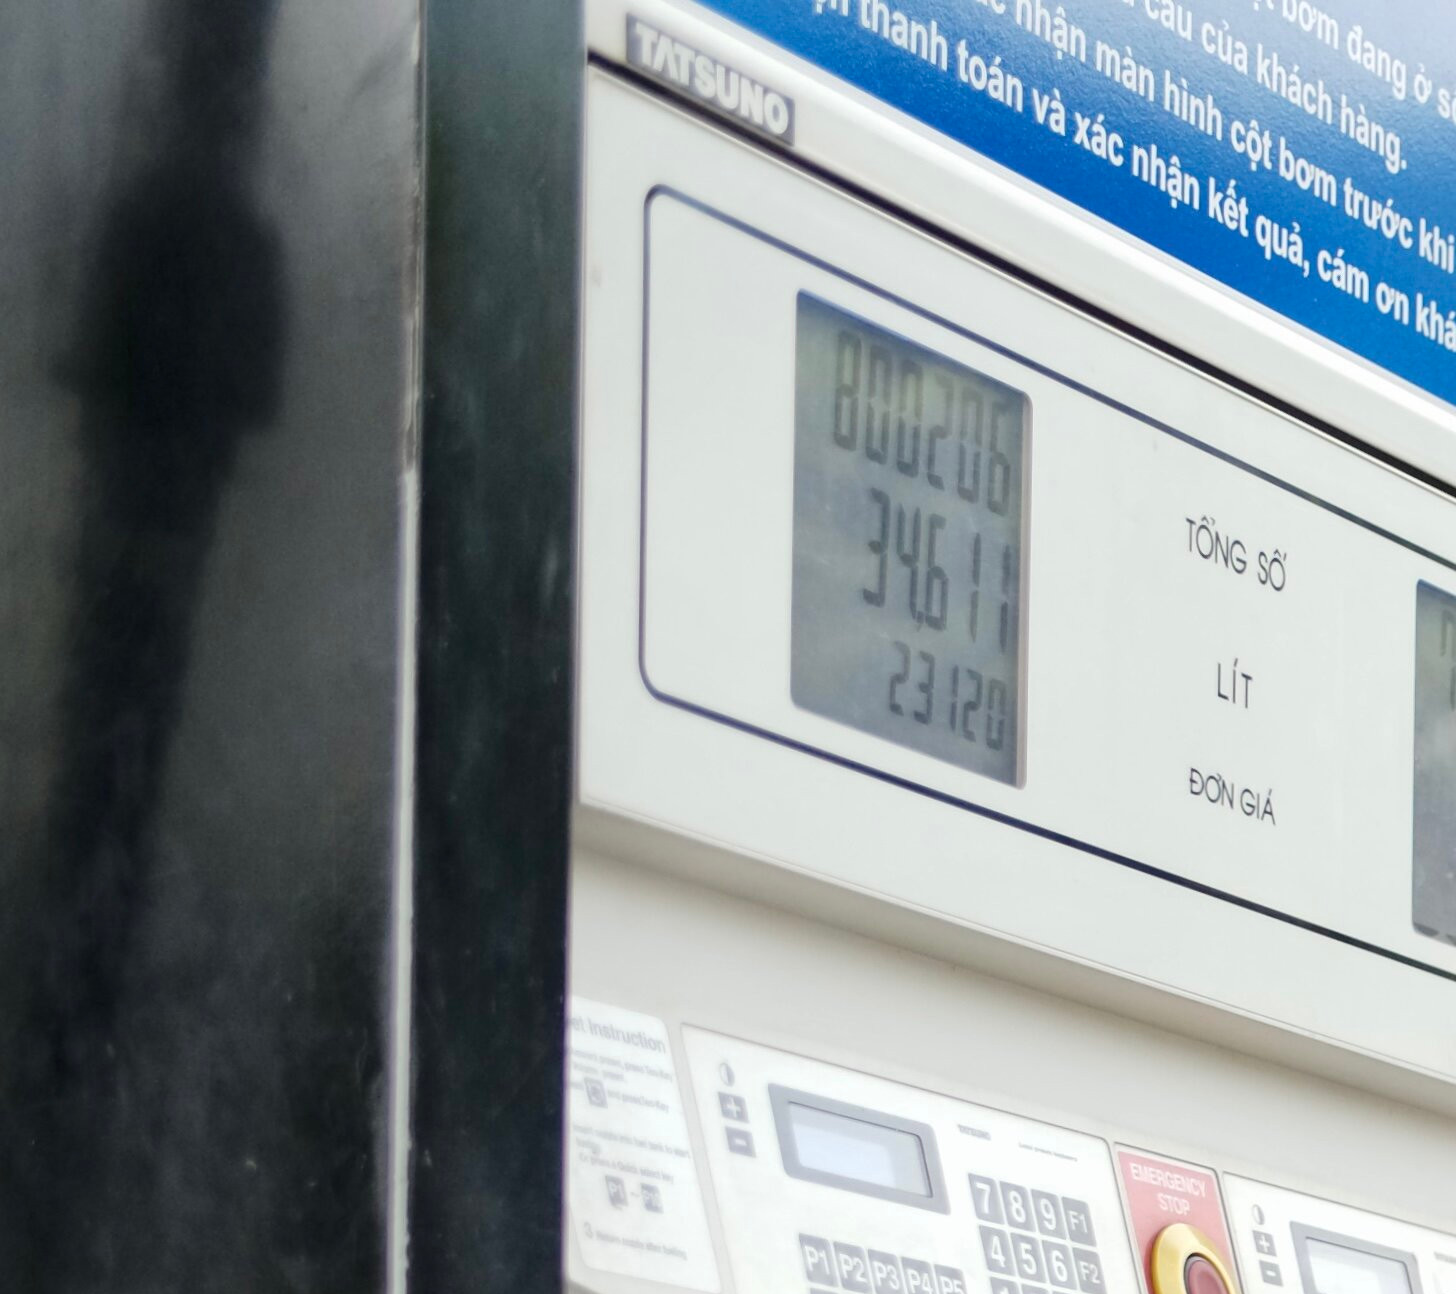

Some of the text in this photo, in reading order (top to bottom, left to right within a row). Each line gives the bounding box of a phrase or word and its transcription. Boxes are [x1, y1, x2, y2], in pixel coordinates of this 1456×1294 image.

[635, 21, 789, 135] TATSUNO
[1347, 24, 1406, 101] đang
[1414, 63, 1432, 104] ở
[1201, 19, 1249, 75] của
[1256, 44, 1334, 125] khách
[1340, 92, 1408, 174] hàng.
[860, 0, 949, 72] thanh
[957, 39, 1024, 113] toán
[1031, 89, 1066, 137] và
[1074, 113, 1124, 167] xác
[1131, 144, 1200, 210] nhận
[1207, 176, 1249, 238] kết
[1255, 213, 1309, 278] quả,
[1317, 248, 1370, 304] cám
[1376, 281, 1409, 325] ơn
[1016, 0, 1086, 63] nhận
[1096, 40, 1155, 102] màn
[1164, 70, 1223, 141] hình
[1230, 119, 1273, 172] cột
[1279, 136, 1338, 207] bơm
[1343, 177, 1413, 250] trước
[1419, 217, 1455, 274] khi
[1186, 515, 1288, 592] TỔNG SỐ
[1217, 658, 1253, 709] LÍT
[1189, 767, 1277, 826] ĐƠN GIÁ
[975, 1182, 1089, 1234] 7 8 9 F1
[1129, 1161, 1207, 1198] EMERGENCY
[1157, 1192, 1191, 1216] STOP
[804, 1245, 831, 1276] P1
[839, 1252, 868, 1283] P2
[873, 1260, 900, 1290] P3
[991, 1235, 1101, 1284] 4 5 6 F2
